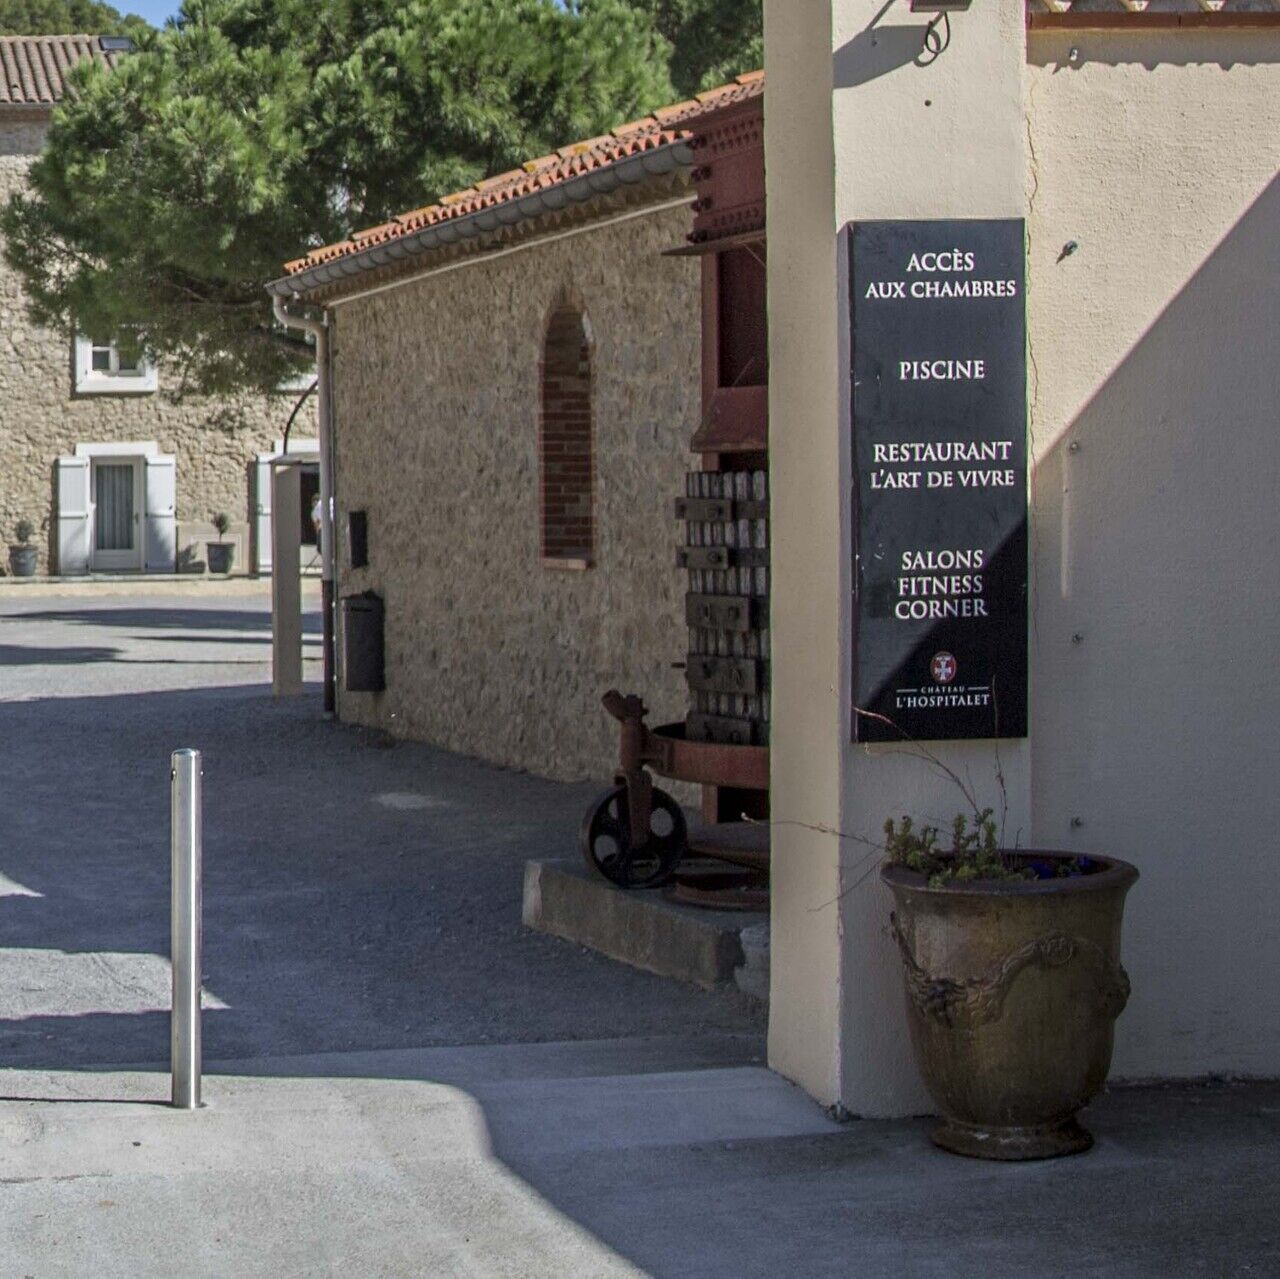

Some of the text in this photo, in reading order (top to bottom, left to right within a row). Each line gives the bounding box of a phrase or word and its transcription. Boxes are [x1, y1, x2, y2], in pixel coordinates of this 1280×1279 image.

[906, 248, 975, 272] ACCÈS
[865, 280, 1016, 298] AUX CHAMBRES
[899, 360, 985, 380] PISCINE
[873, 441, 1012, 463] RESTAURANT
[870, 469, 1015, 489] L'ART DE VIVRE
[901, 549, 983, 570] SALONS
[898, 575, 983, 596] FITNESS
[895, 598, 988, 619] CORNER
[896, 694, 990, 708] L'HOSPITALET
